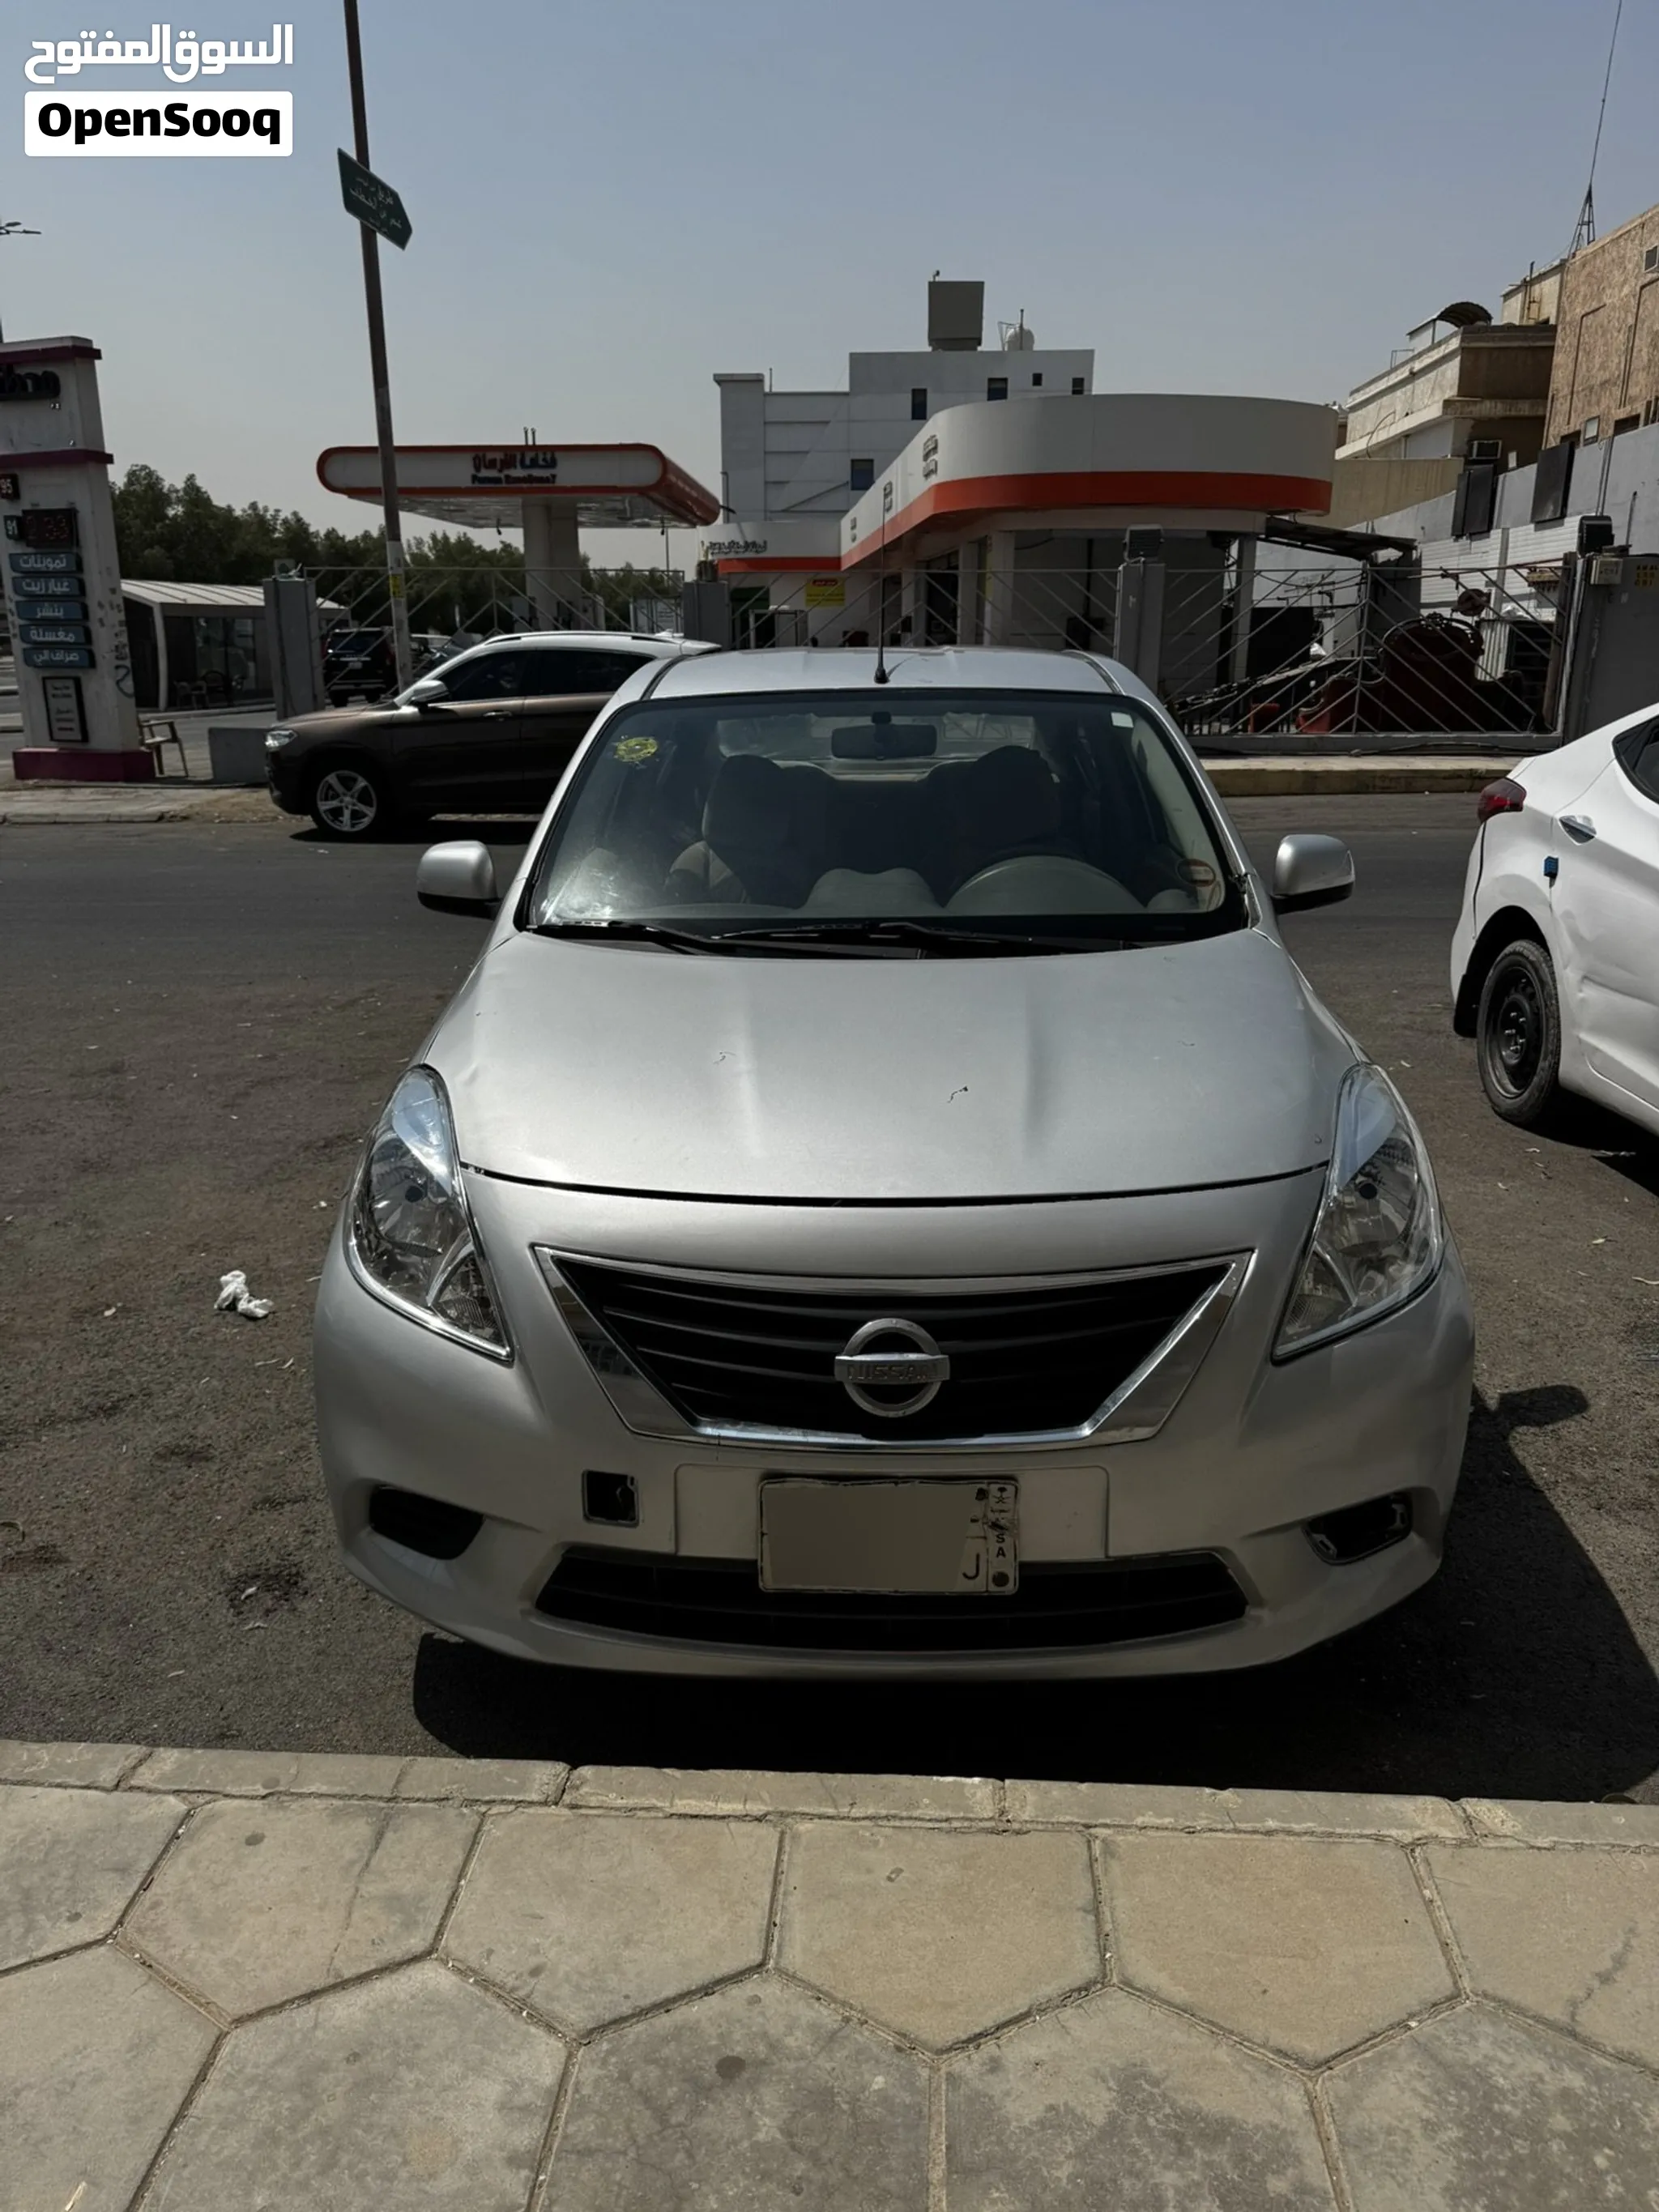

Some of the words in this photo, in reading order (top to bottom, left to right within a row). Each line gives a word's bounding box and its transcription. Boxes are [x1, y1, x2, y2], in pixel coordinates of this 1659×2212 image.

[19, 554, 67, 569] تموينات
[22, 578, 45, 593] زيت
[48, 580, 70, 595] غيار
[36, 603, 64, 619] بنشر
[29, 626, 75, 643] مغسلة
[51, 650, 79, 663] صراف
